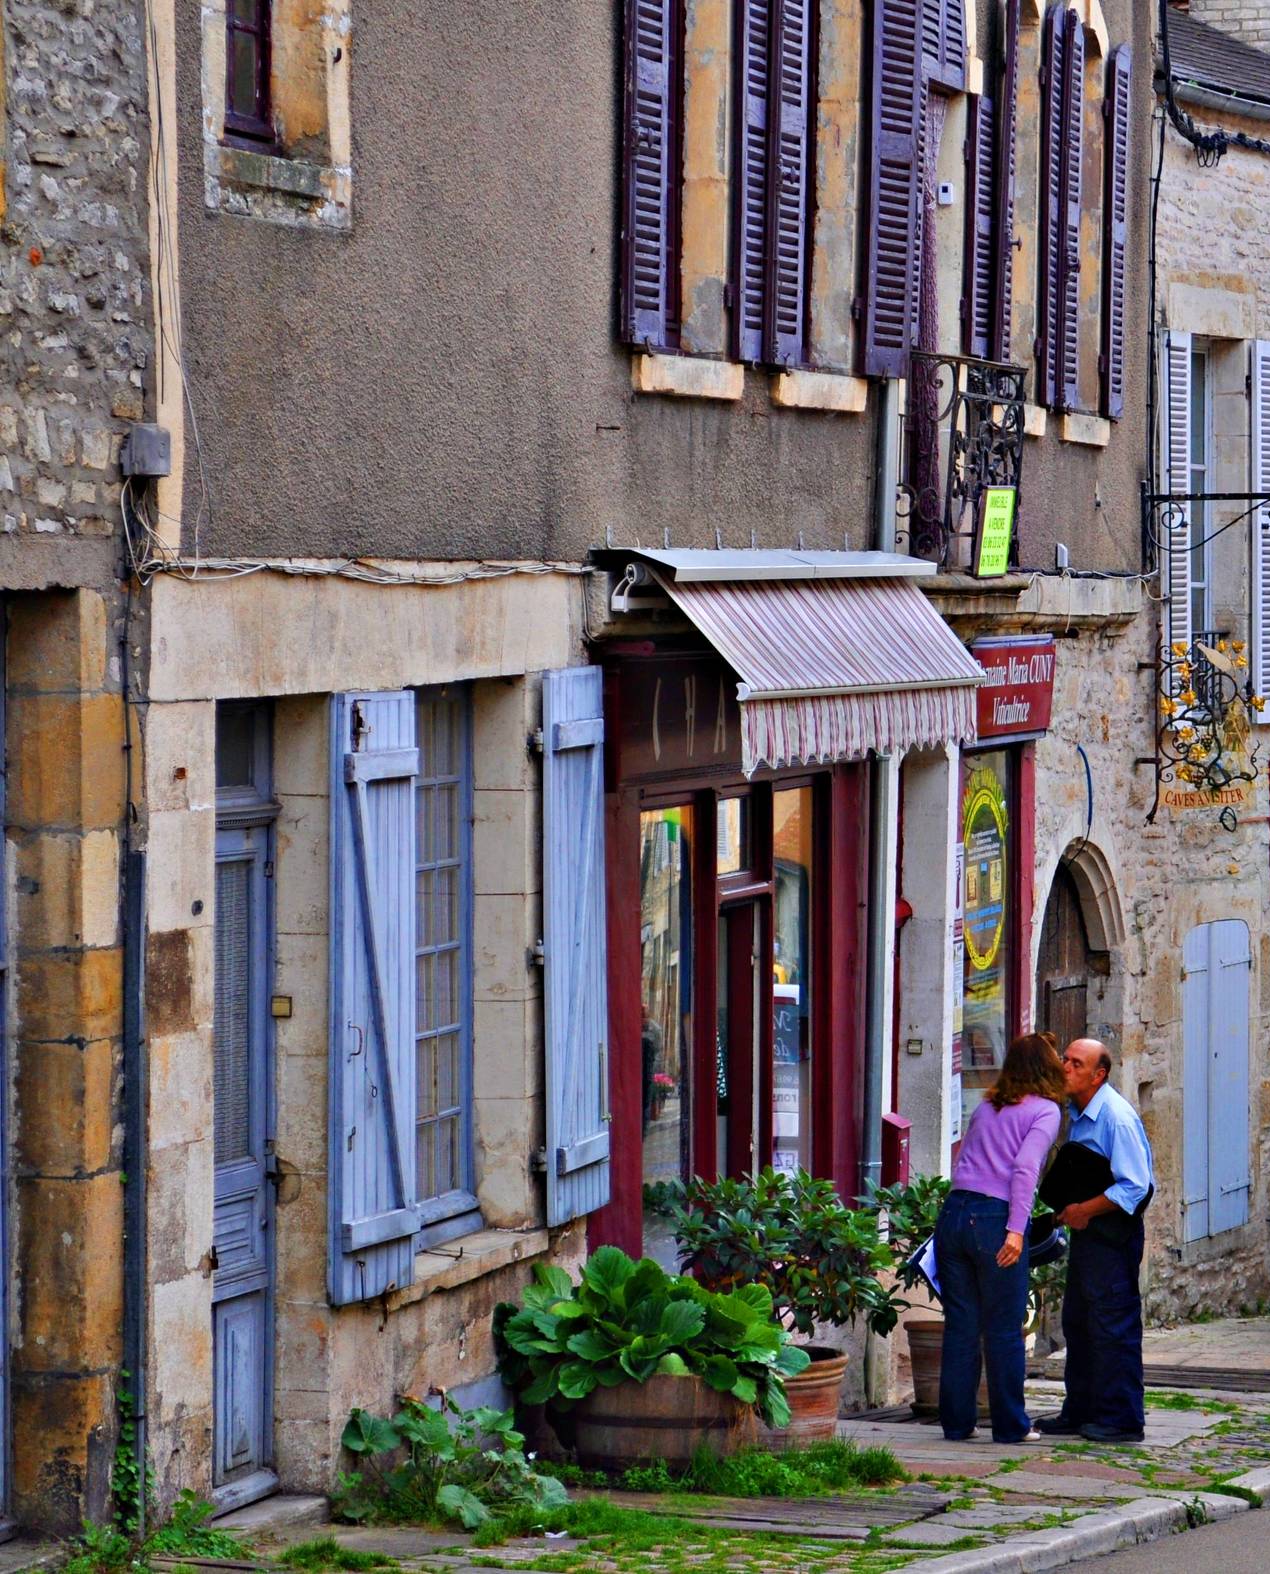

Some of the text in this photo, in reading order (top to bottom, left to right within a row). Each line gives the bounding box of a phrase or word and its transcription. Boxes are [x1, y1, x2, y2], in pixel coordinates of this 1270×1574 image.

[1007, 656, 1028, 686] Maria
[1029, 654, 1054, 684] CUNY
[992, 694, 1030, 727] Viticultrice
[1165, 790, 1194, 807] CAVES
[1204, 788, 1244, 804] VISITER
